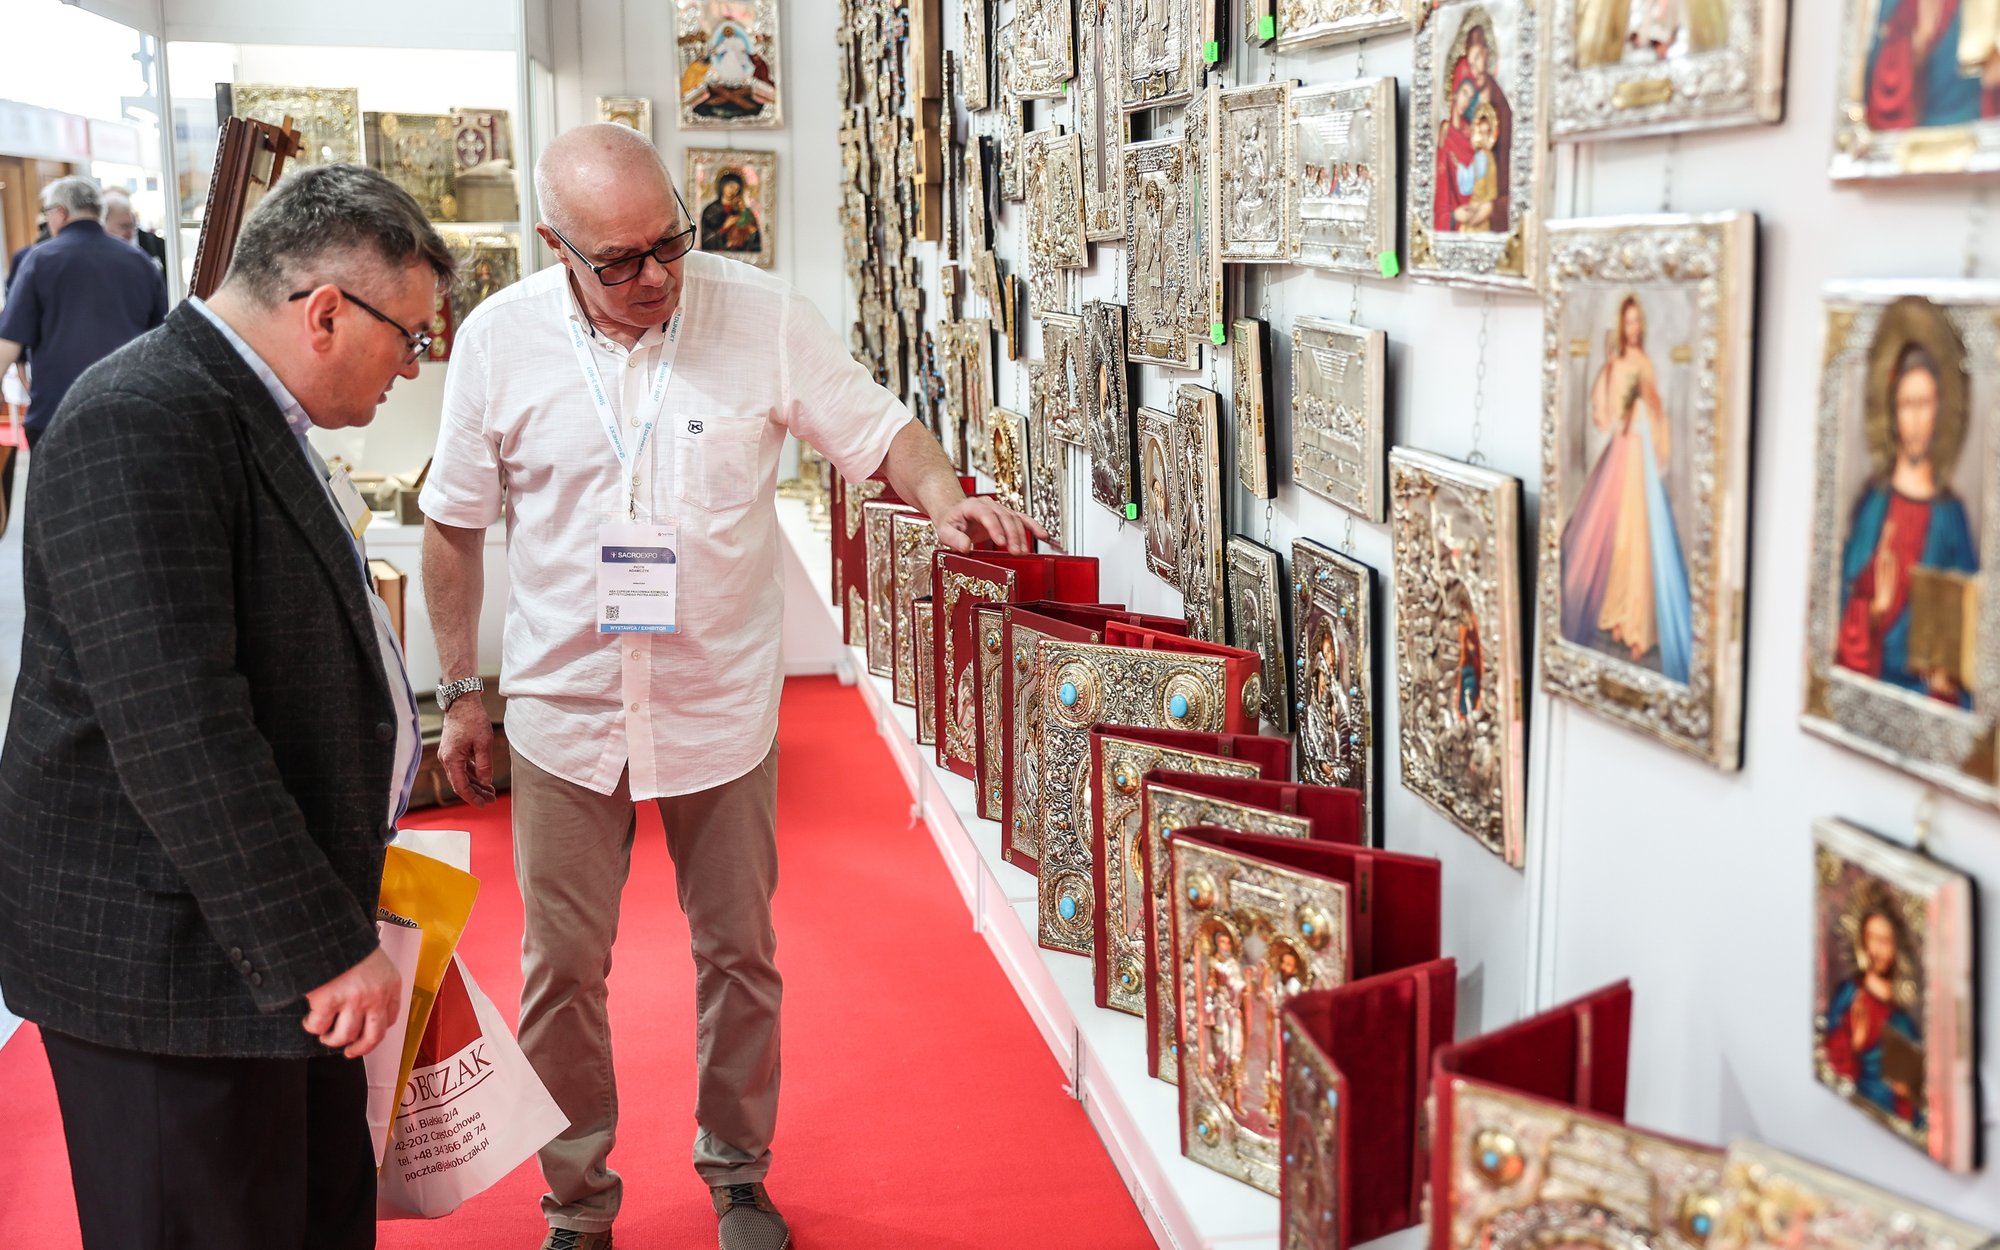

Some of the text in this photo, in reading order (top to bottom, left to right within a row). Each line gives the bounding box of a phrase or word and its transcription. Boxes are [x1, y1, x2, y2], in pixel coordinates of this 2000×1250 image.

[617, 551, 658, 559] SACROEXPO
[405, 1119, 418, 1134] ul.
[443, 1107, 459, 1122] 2/4
[395, 1133, 430, 1151] 42-202
[398, 1155, 412, 1168] tel.
[413, 1148, 432, 1162] +48
[462, 1130, 474, 1145] 48
[474, 1121, 487, 1137] 74
[404, 1137, 490, 1183] poczta@jakobczak.pl
